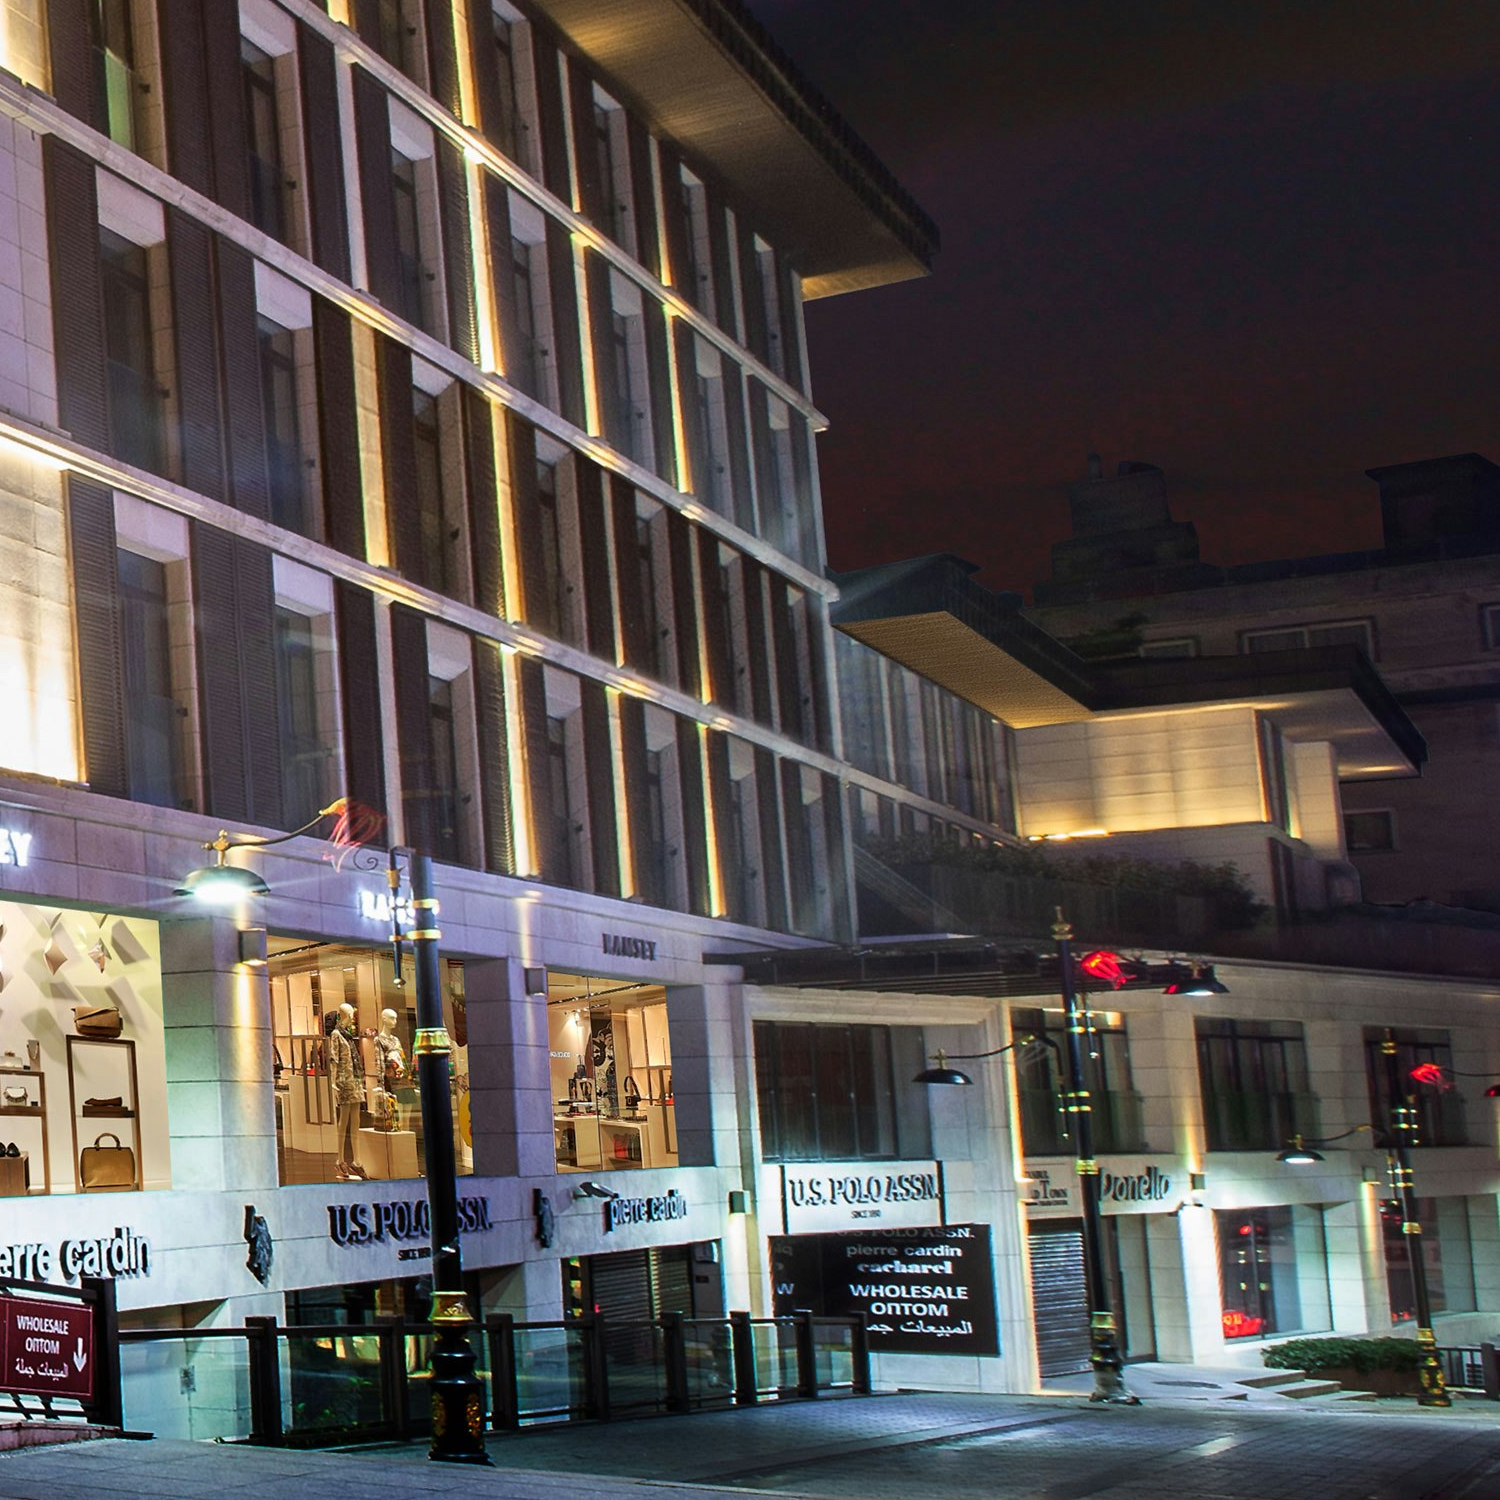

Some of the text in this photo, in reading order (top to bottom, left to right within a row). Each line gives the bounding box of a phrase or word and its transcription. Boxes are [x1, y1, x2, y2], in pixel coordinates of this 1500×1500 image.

[789, 1173, 942, 1206] U.S. POLO ASSN.
[328, 1203, 373, 1246] U.S.
[871, 1226, 919, 1238] POLO
[61, 1227, 152, 1280] cardin
[846, 1244, 963, 1257] pierre cardin
[856, 1260, 953, 1275] cacharel
[850, 1284, 969, 1300] WHOLESALE
[870, 1301, 948, 1317] ОПТОМ
[16, 1314, 69, 1335] WHOLESALE
[899, 1319, 974, 1338] المبيعات
